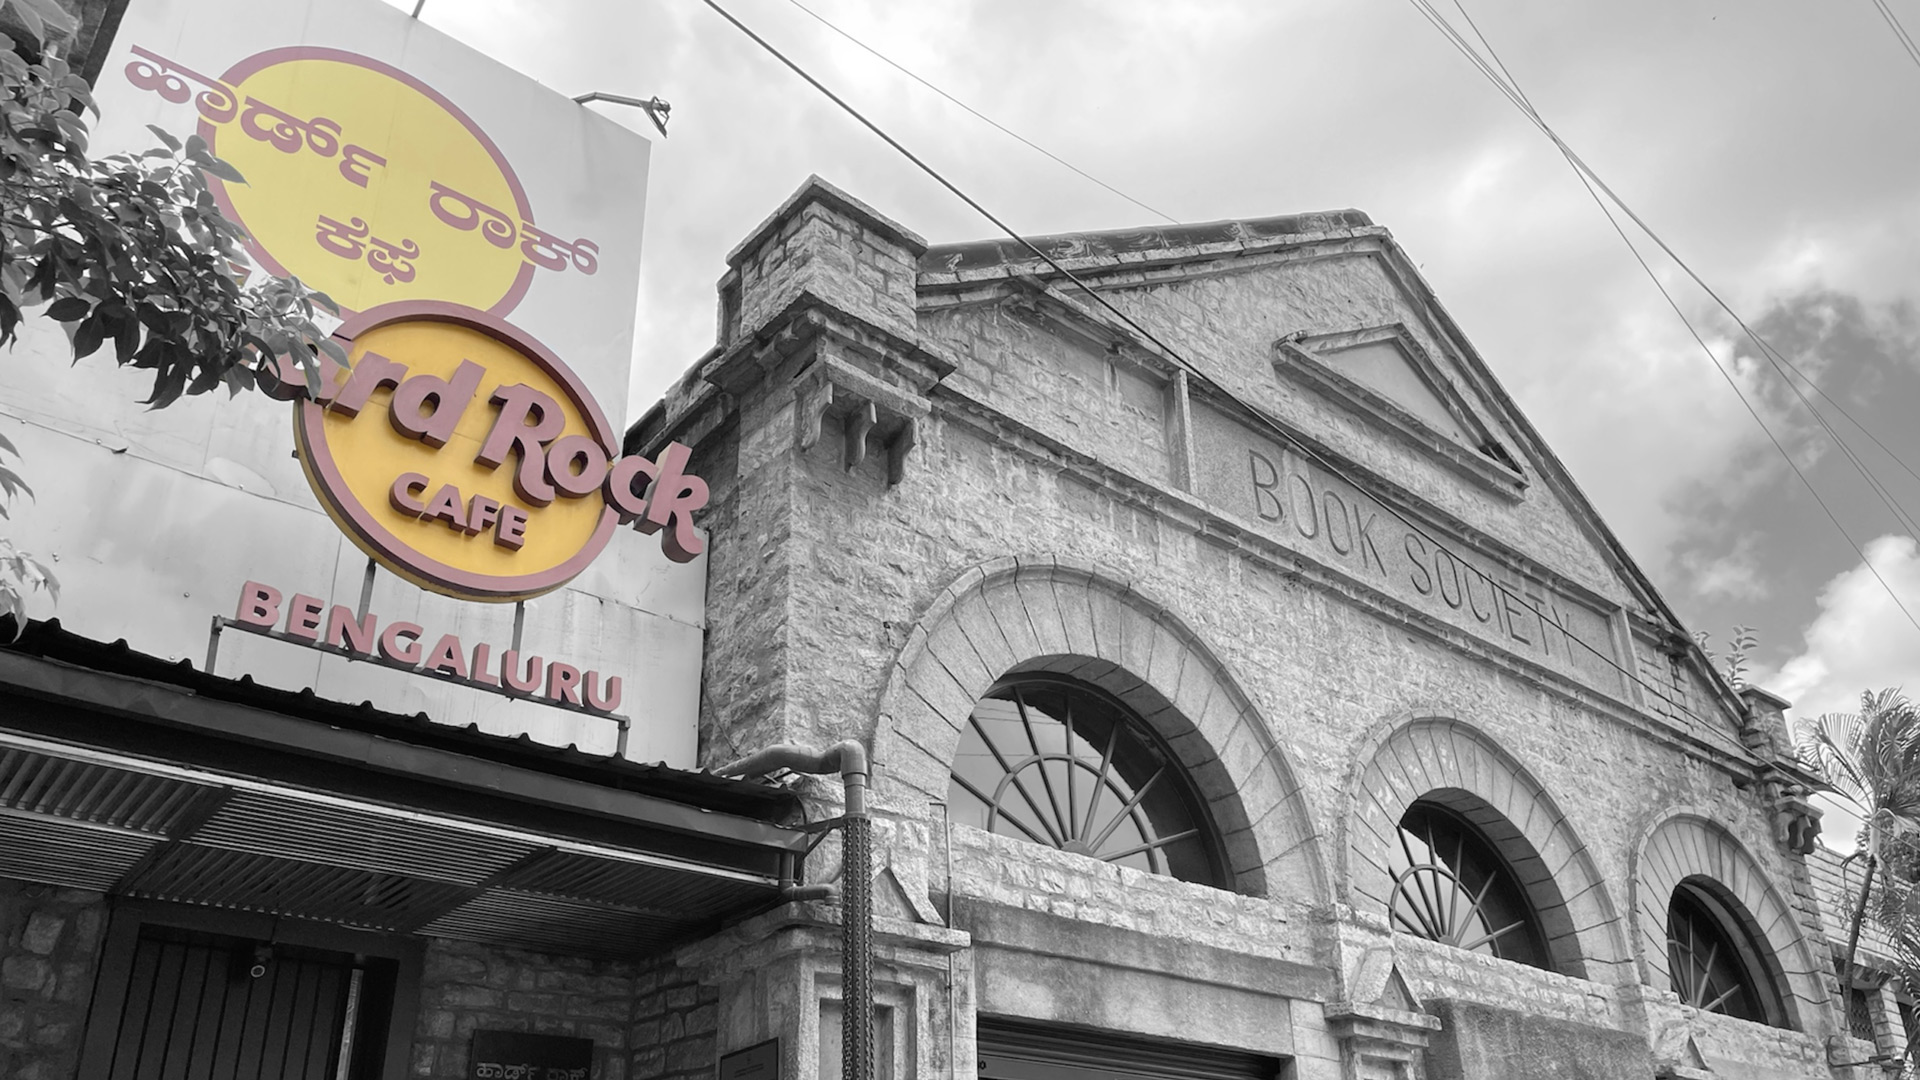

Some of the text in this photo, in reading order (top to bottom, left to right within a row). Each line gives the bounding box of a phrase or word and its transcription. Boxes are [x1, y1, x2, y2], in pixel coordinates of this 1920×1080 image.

[124, 44, 599, 276] ಹಾರ್ಡ್ ರಾಕ್
[316, 214, 420, 285] ಕೆಫೆ
[256, 343, 710, 564] rd Rock
[389, 472, 528, 552] CAFE
[1248, 449, 1575, 667] BOOK SOCIETY
[235, 580, 623, 713] BENGALURU
